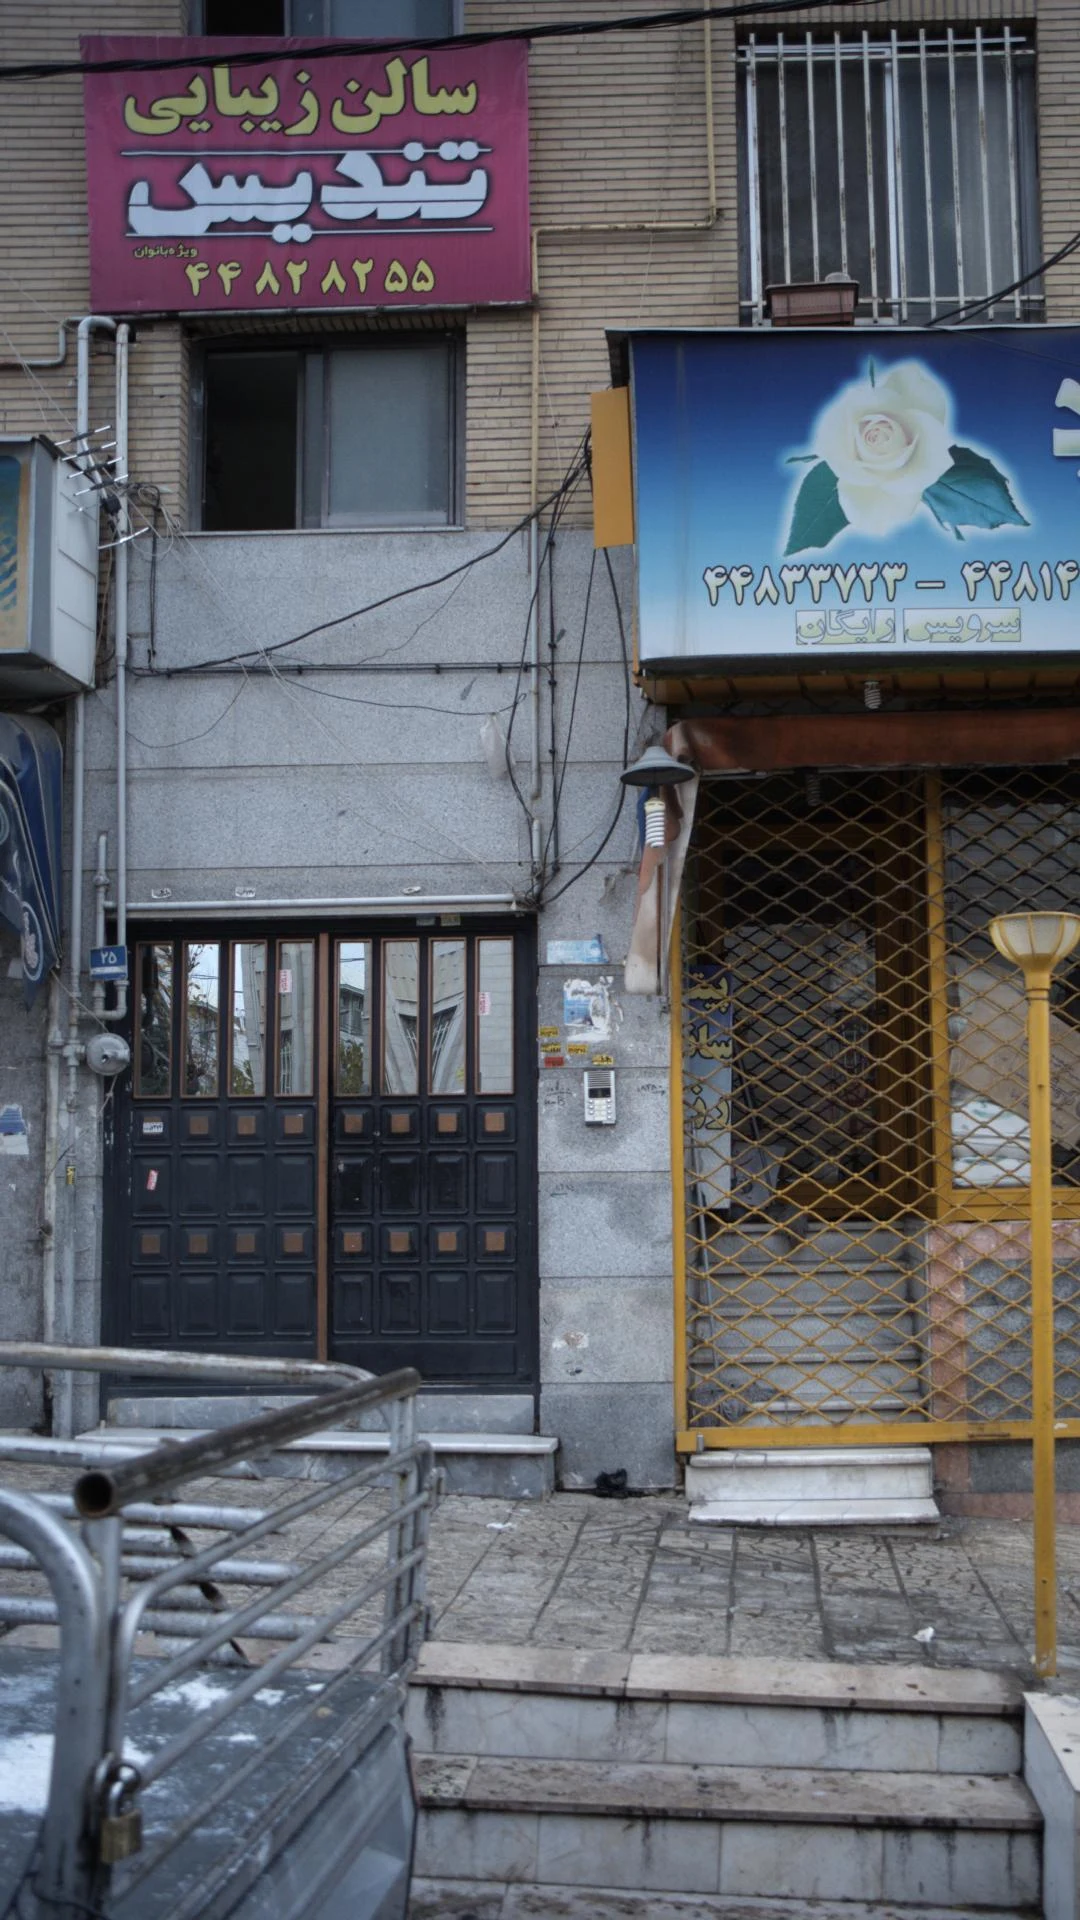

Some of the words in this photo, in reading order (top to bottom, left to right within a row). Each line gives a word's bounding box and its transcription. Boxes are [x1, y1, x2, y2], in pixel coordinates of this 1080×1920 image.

[124, 63, 320, 136] زیبایی
[330, 56, 478, 134] سالن
[127, 140, 489, 243] تندیس
[702, 562, 907, 606] ۴۴۸۳۳۷۲۳
[795, 607, 896, 645] رایگان
[903, 607, 1021, 643] سرویس
[100, 950, 118, 965] ۲۵
